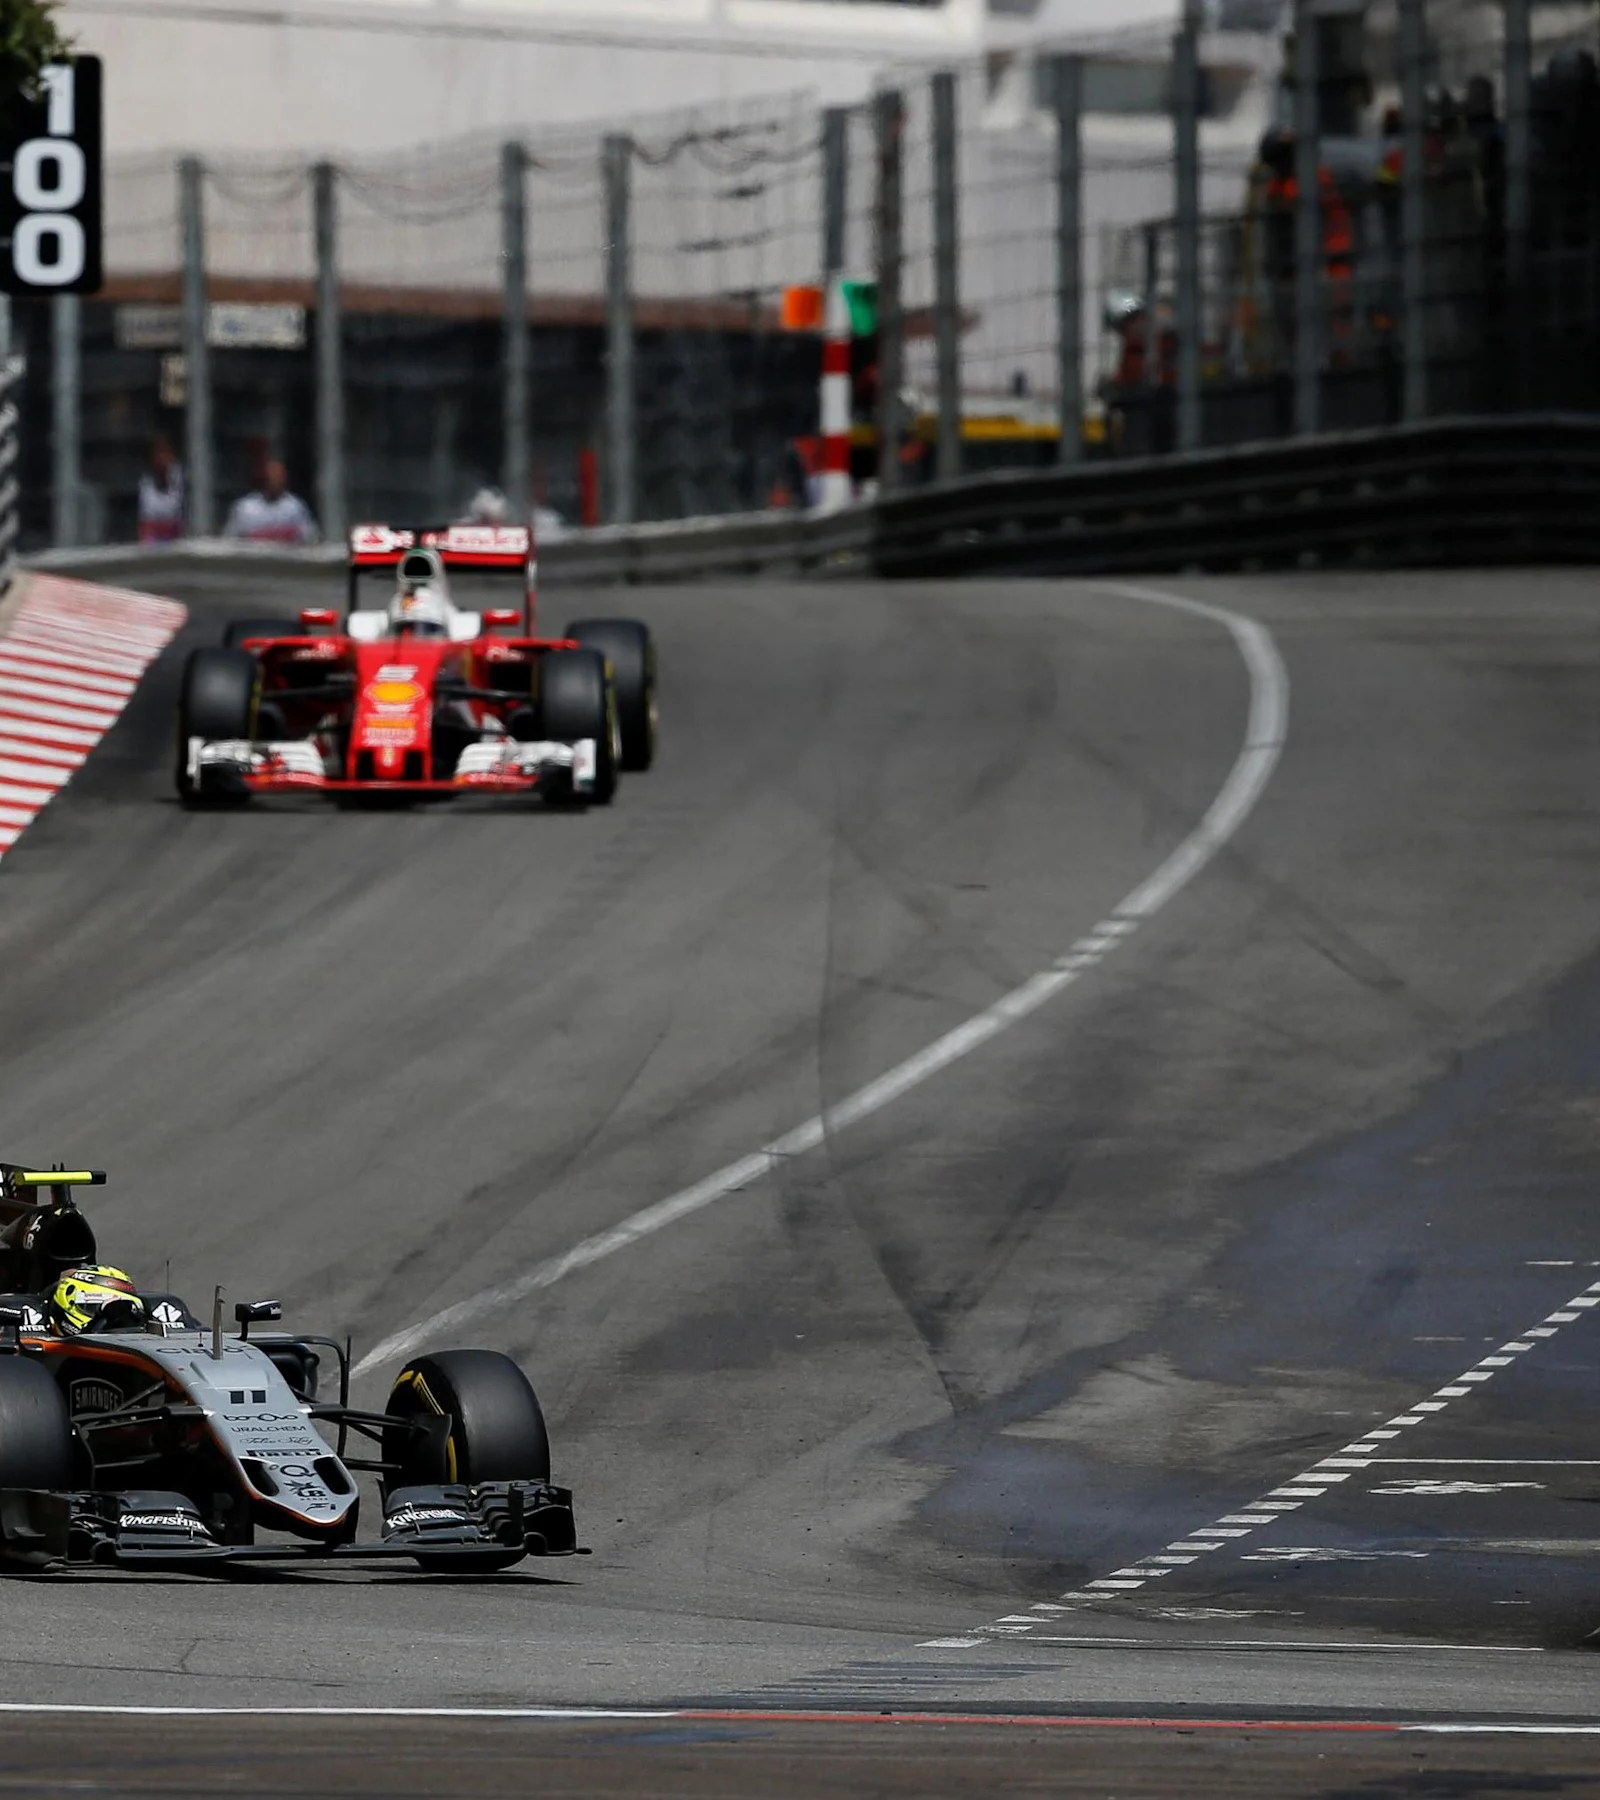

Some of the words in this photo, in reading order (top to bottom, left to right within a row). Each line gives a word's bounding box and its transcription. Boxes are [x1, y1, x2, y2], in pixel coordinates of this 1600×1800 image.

[13, 64, 86, 286] 100
[18, 1324, 47, 1332] NTER
[231, 1425, 307, 1433] URALCHEM
[246, 1448, 322, 1457] PIRELLI
[119, 1514, 213, 1537] KINGFISHER
